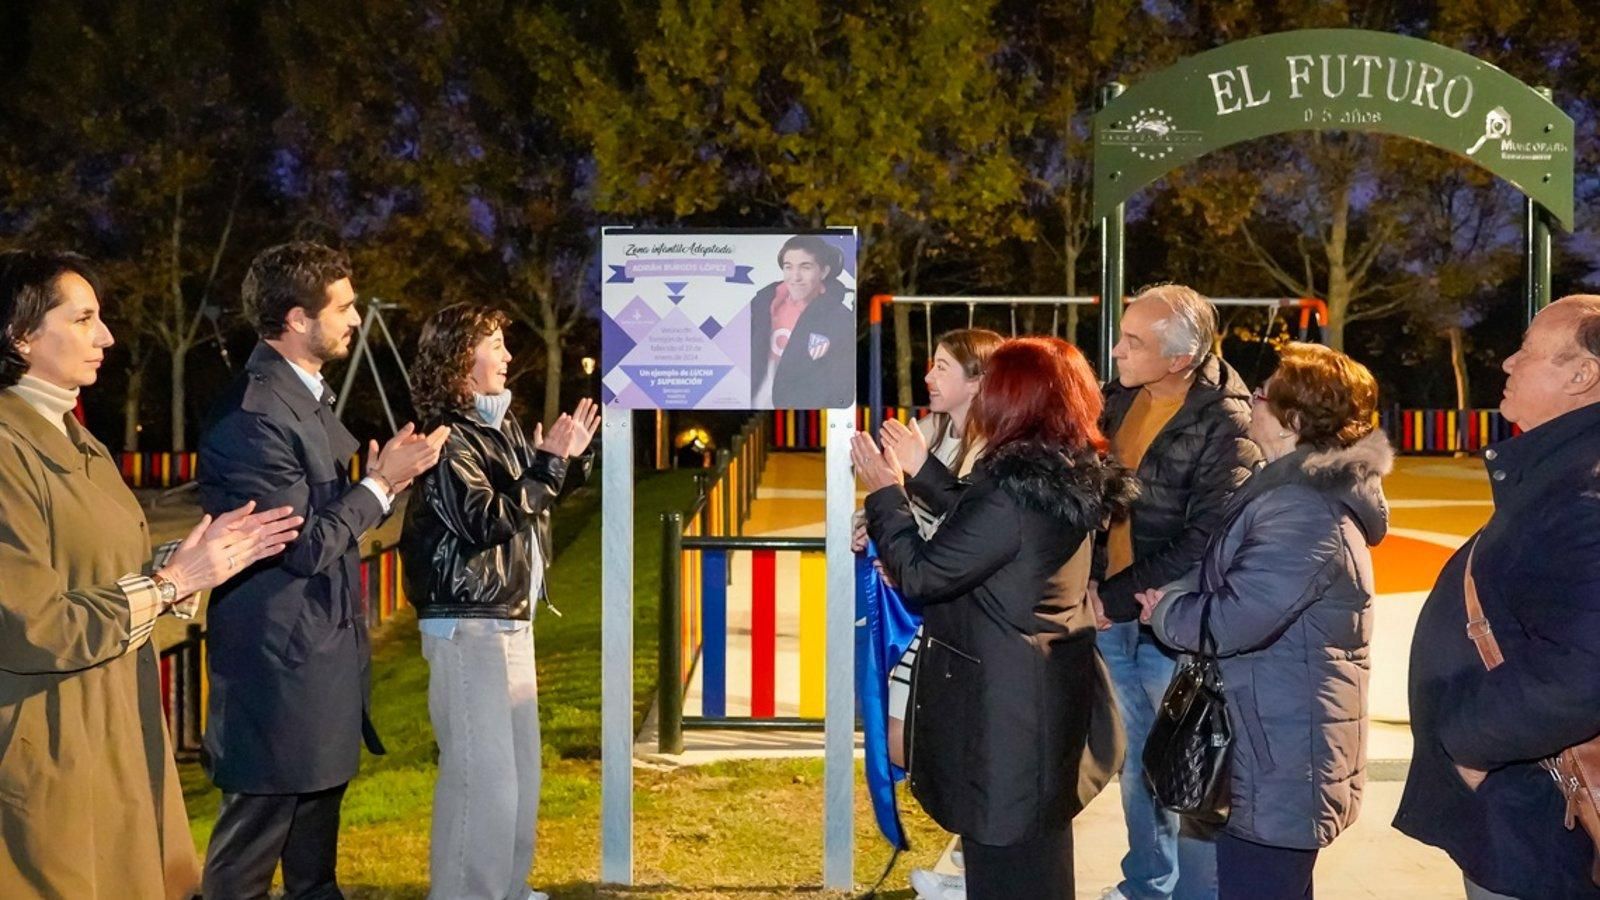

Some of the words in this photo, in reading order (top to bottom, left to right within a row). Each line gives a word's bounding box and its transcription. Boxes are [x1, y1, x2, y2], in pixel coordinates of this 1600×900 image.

[1208, 65, 1271, 116] EL
[1286, 54, 1474, 118] FUTURO
[625, 243, 649, 257] Zona
[684, 242, 733, 257] Adaptada
[651, 368, 679, 378] ejemplo
[657, 377, 703, 386] SUPERACIÓN
